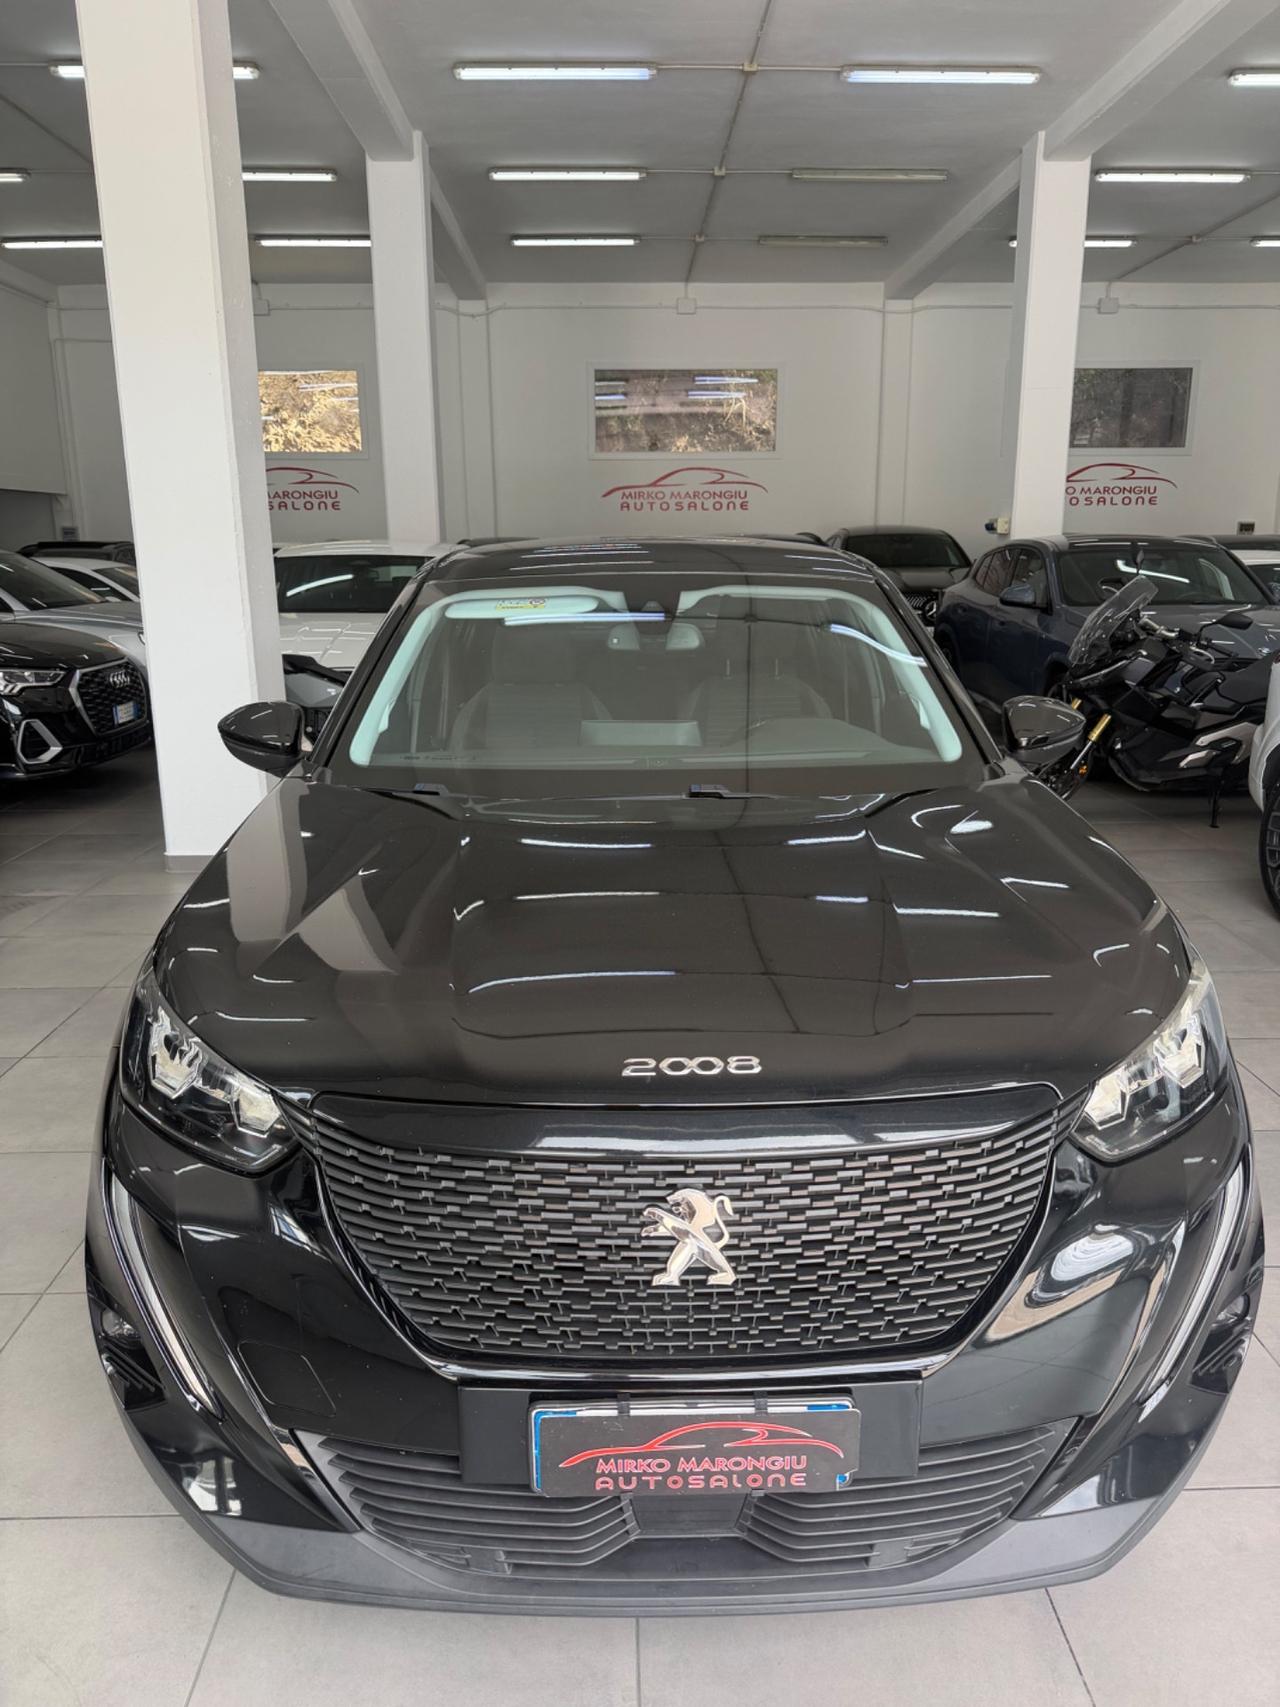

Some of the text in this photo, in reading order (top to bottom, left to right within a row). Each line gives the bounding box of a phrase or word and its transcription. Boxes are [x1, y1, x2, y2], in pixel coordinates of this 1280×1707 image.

[620, 490, 748, 500] MIRKO MARONGIU
[1080, 485, 1157, 495] MARONGIU
[620, 501, 749, 512] AUTOSALONE
[622, 1055, 763, 1077] 2008
[595, 1455, 807, 1474] MIRKO MARONGIU
[594, 1473, 807, 1490] AUTOSALONE
